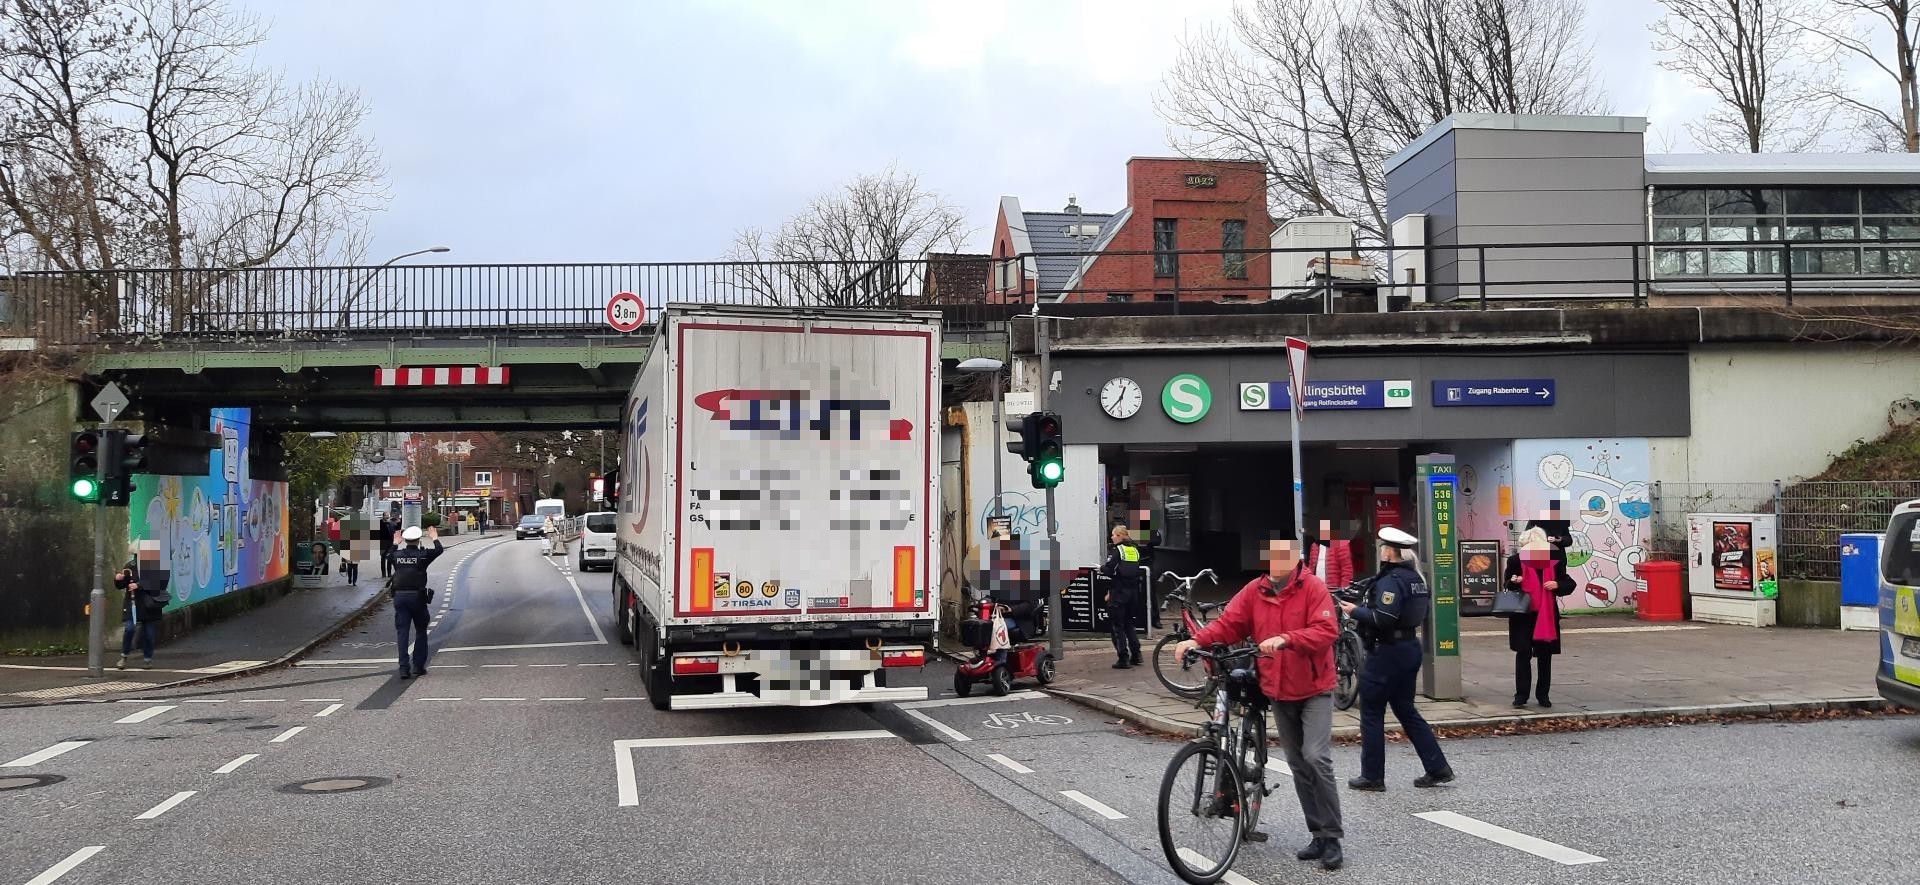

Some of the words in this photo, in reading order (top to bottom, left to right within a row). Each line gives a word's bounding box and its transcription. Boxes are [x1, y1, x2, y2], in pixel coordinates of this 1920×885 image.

[1187, 176, 1214, 186] 2022
[1467, 387, 1492, 395] Zugang
[1169, 378, 1203, 419] S
[1432, 465, 1452, 473] TAXI
[1434, 490, 1451, 499] 536
[1437, 501, 1448, 510] 09
[739, 585, 750, 594] 80
[764, 585, 776, 593] 70
